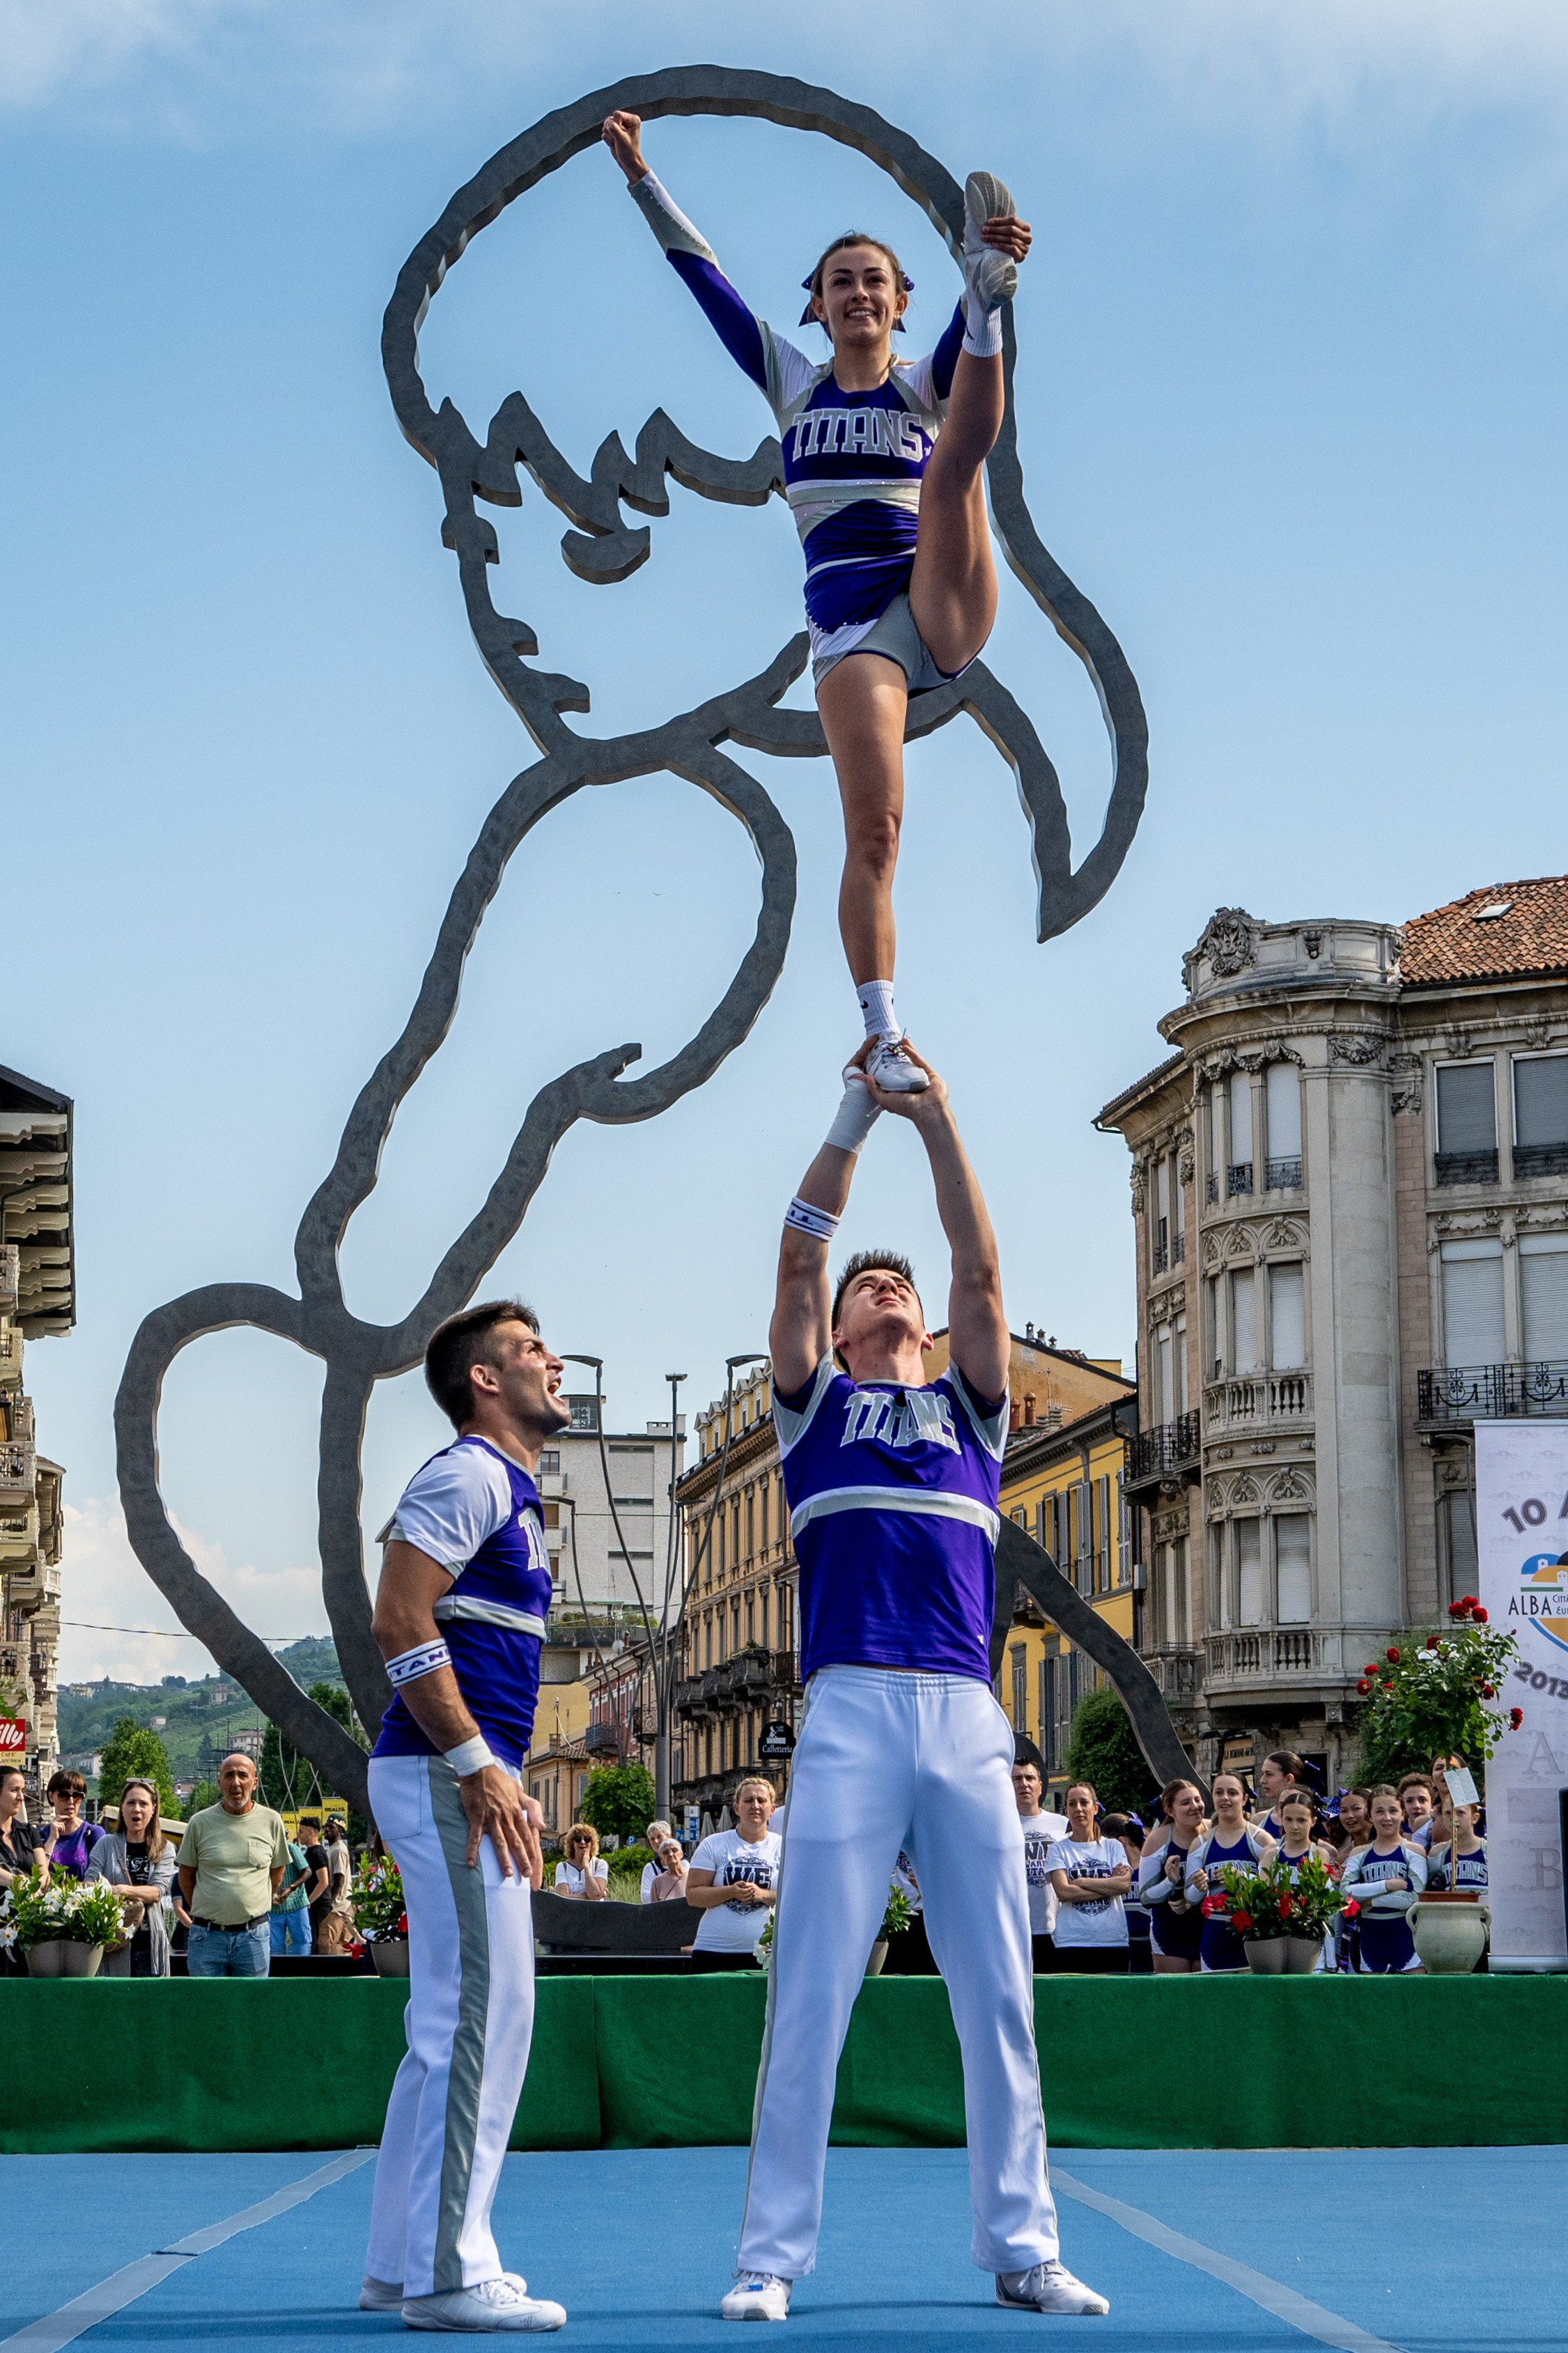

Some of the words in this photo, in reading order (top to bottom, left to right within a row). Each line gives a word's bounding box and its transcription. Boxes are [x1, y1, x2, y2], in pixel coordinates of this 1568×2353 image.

[792, 407, 922, 463] TITANS
[839, 1391, 961, 1455] TITANS
[1500, 1497, 1548, 1534] 10
[1508, 1595, 1552, 1615] ALBA
[389, 1649, 449, 1678] TAN
[1512, 1662, 1568, 1700] 2013
[1361, 1860, 1407, 1883] TITANS
